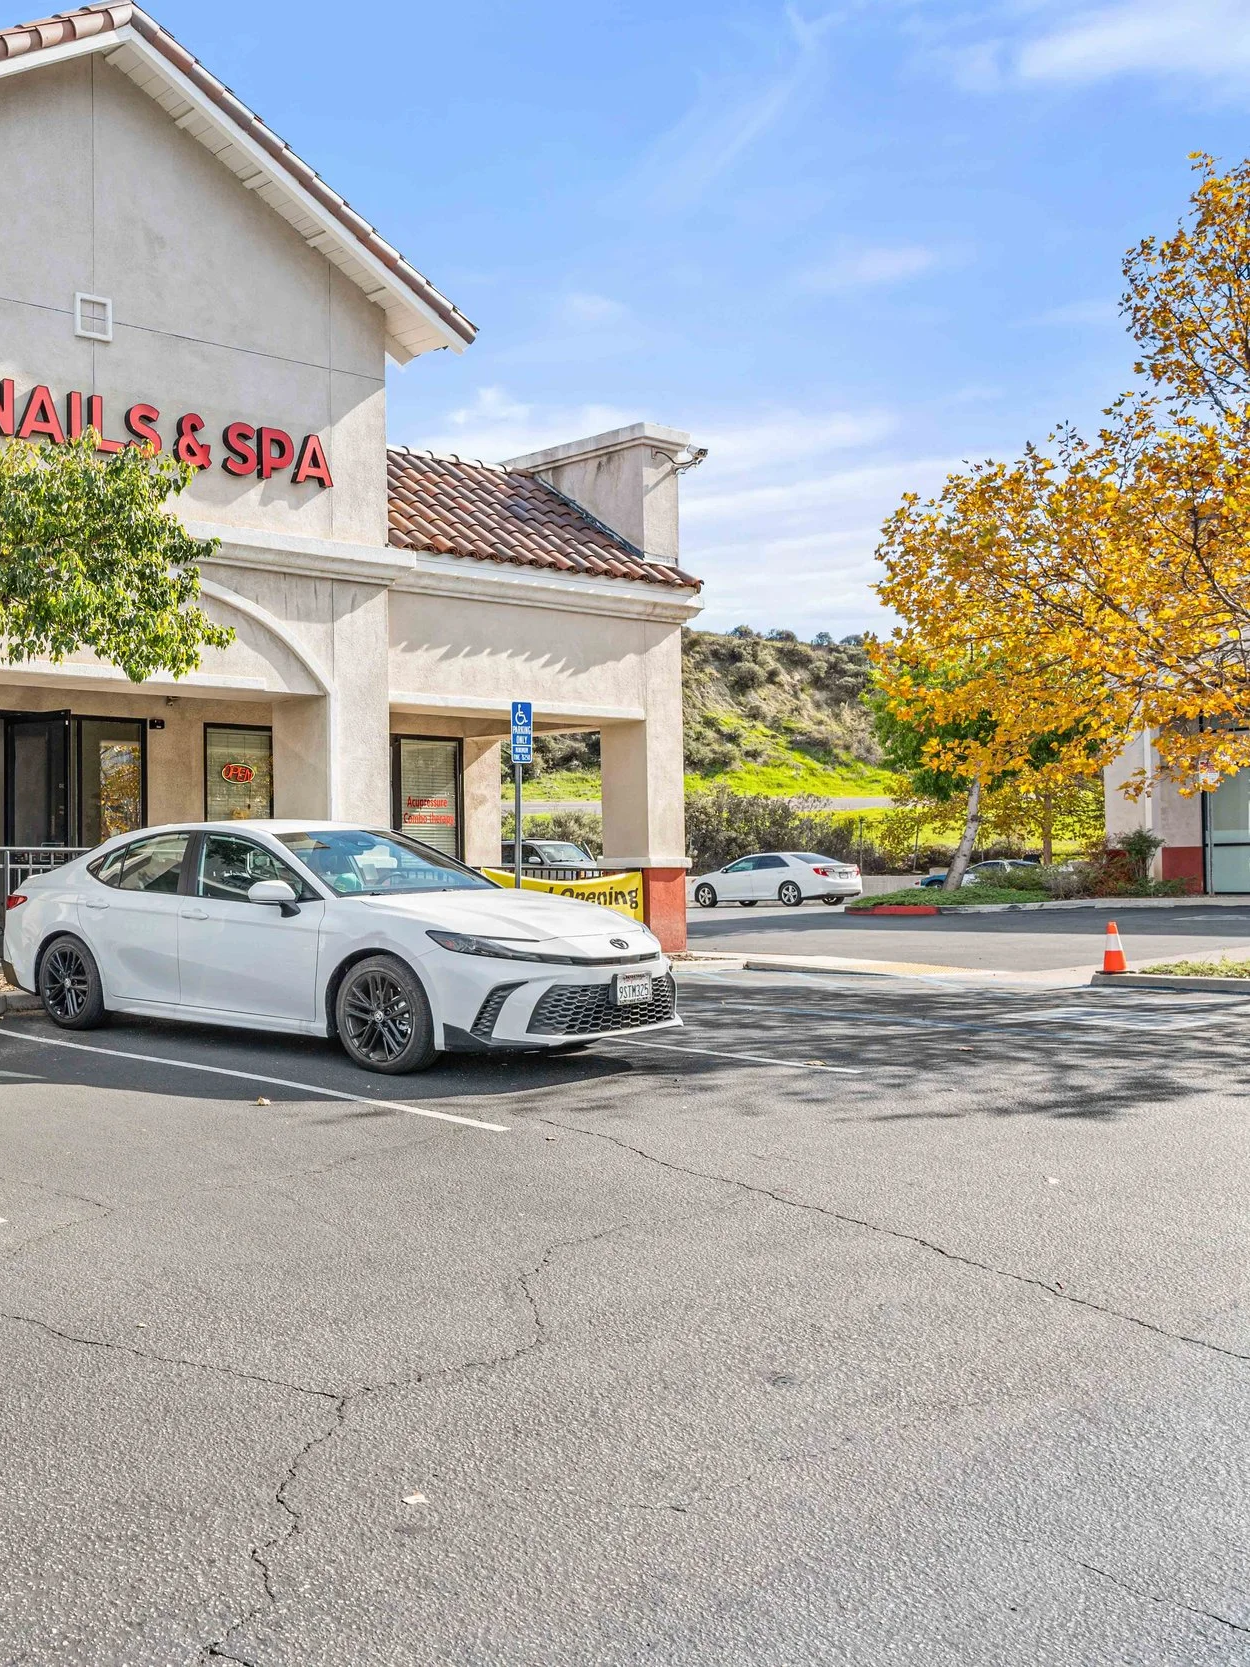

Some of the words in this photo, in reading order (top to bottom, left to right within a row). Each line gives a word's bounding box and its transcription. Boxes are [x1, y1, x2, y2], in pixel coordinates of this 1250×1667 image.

[173, 412, 213, 470] &
[221, 421, 334, 489] SPA
[516, 735, 527, 745] ONLY
[223, 764, 253, 783] OPEN
[406, 796, 448, 810] Acupressure
